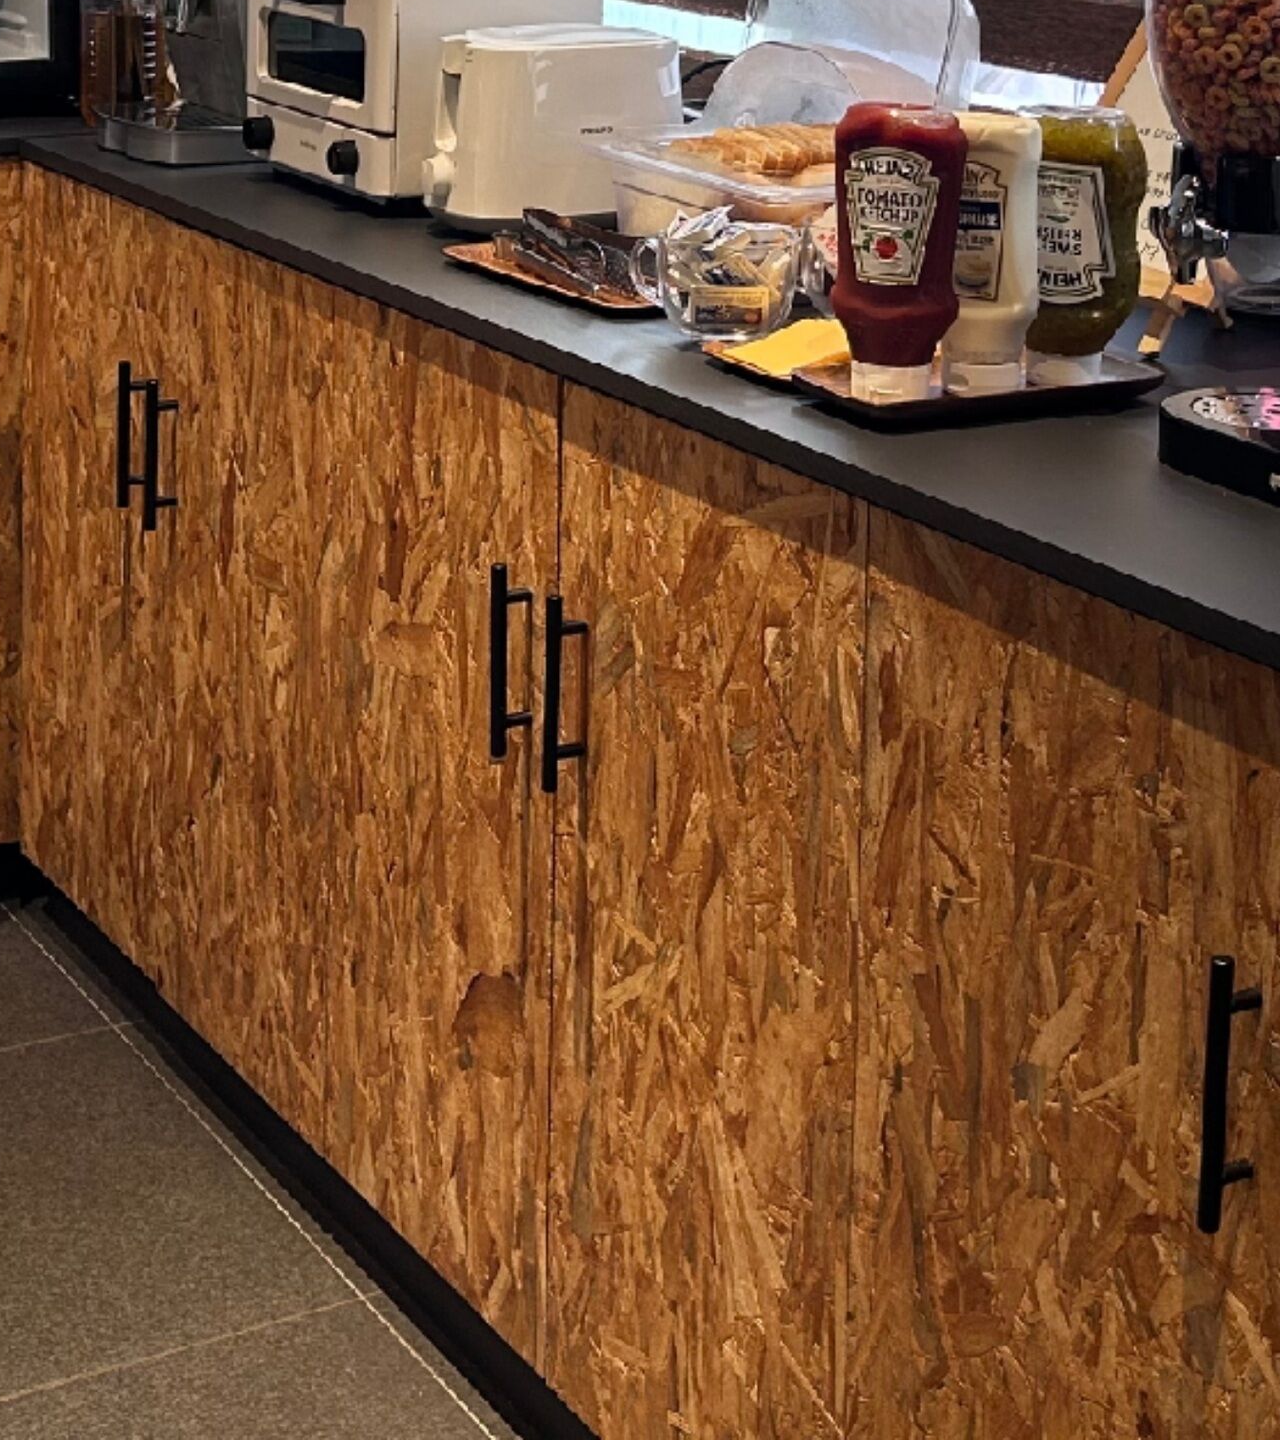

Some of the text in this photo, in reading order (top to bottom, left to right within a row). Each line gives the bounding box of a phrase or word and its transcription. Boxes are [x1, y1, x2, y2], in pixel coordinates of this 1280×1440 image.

[857, 187, 923, 208] TOMATO
[859, 205, 919, 223] KETCHUP
[1037, 270, 1082, 287] HEIN
